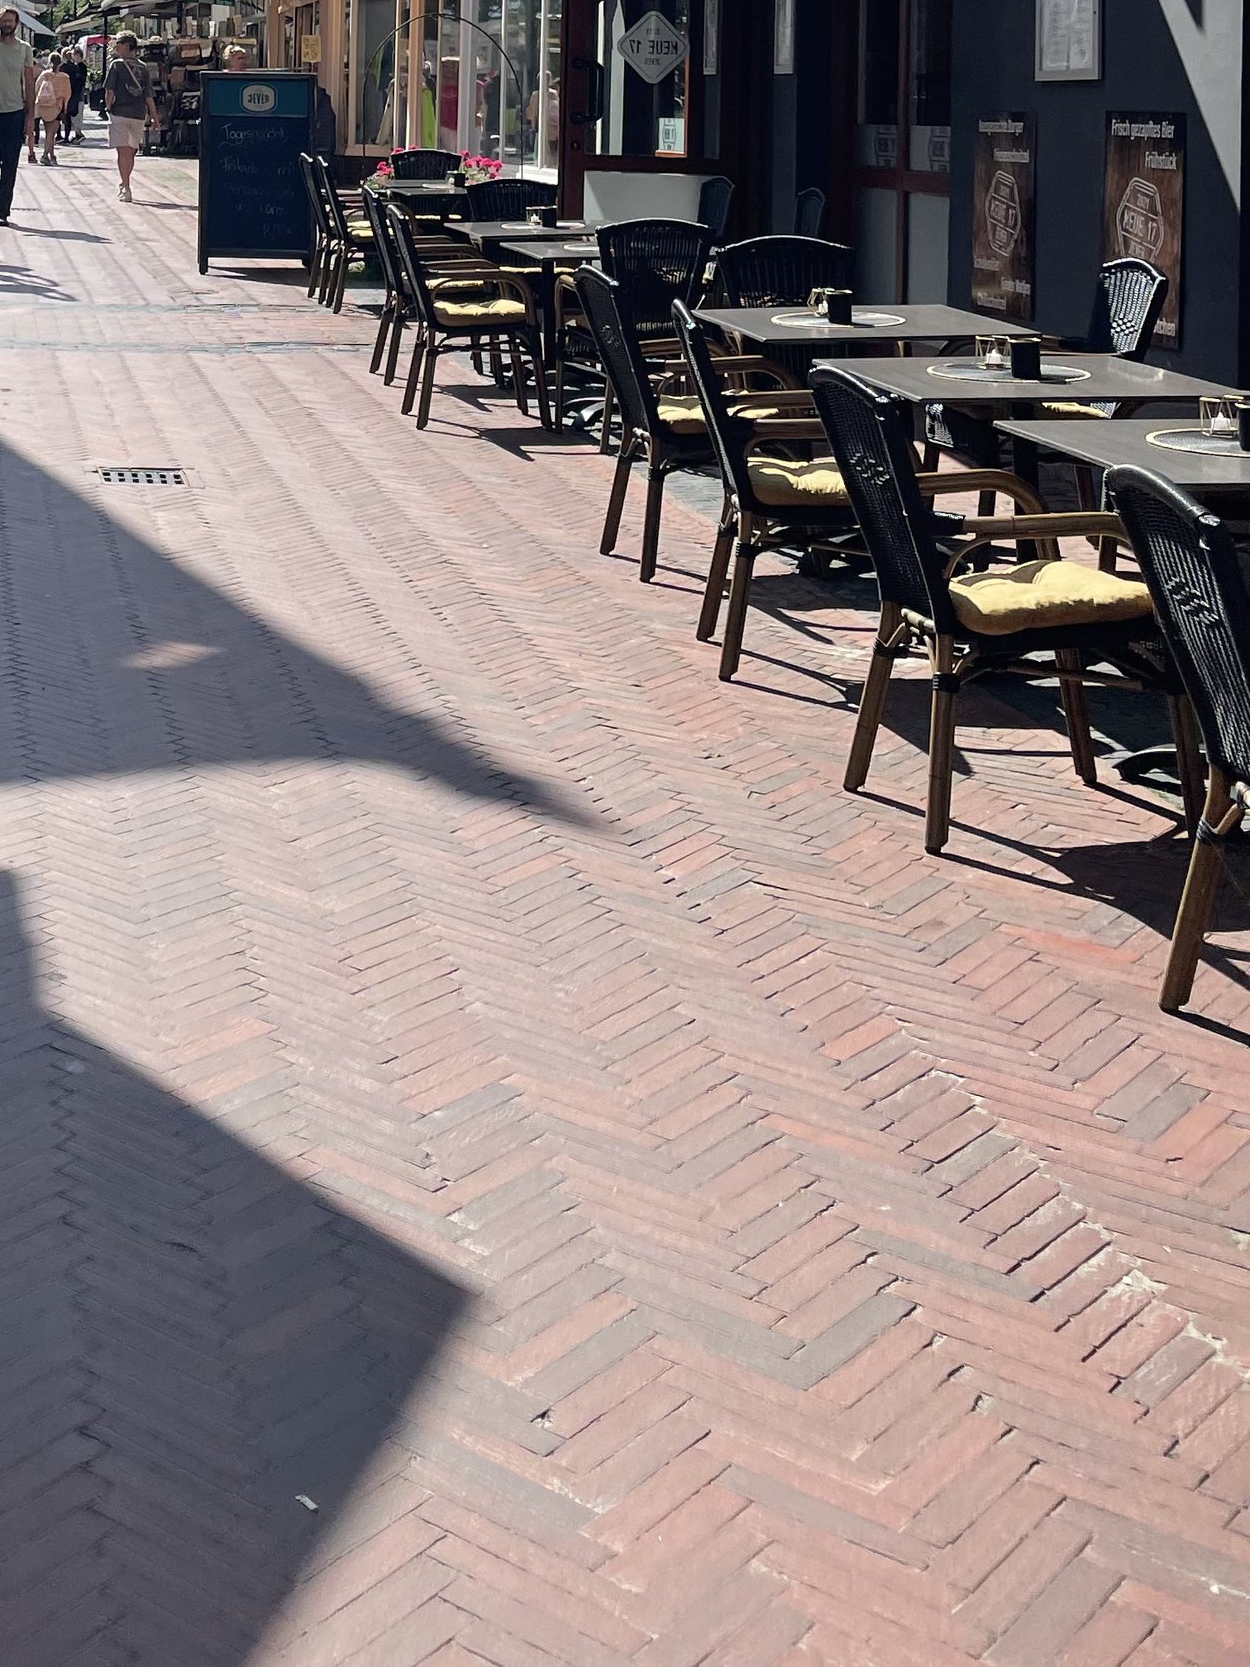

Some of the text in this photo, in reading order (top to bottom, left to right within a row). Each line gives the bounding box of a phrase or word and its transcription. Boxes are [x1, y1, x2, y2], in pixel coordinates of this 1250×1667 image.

[247, 92, 270, 105] JEVER
[1111, 119, 1175, 140] Frisch gezapftes Bier
[1145, 151, 1177, 170] Frühstück
